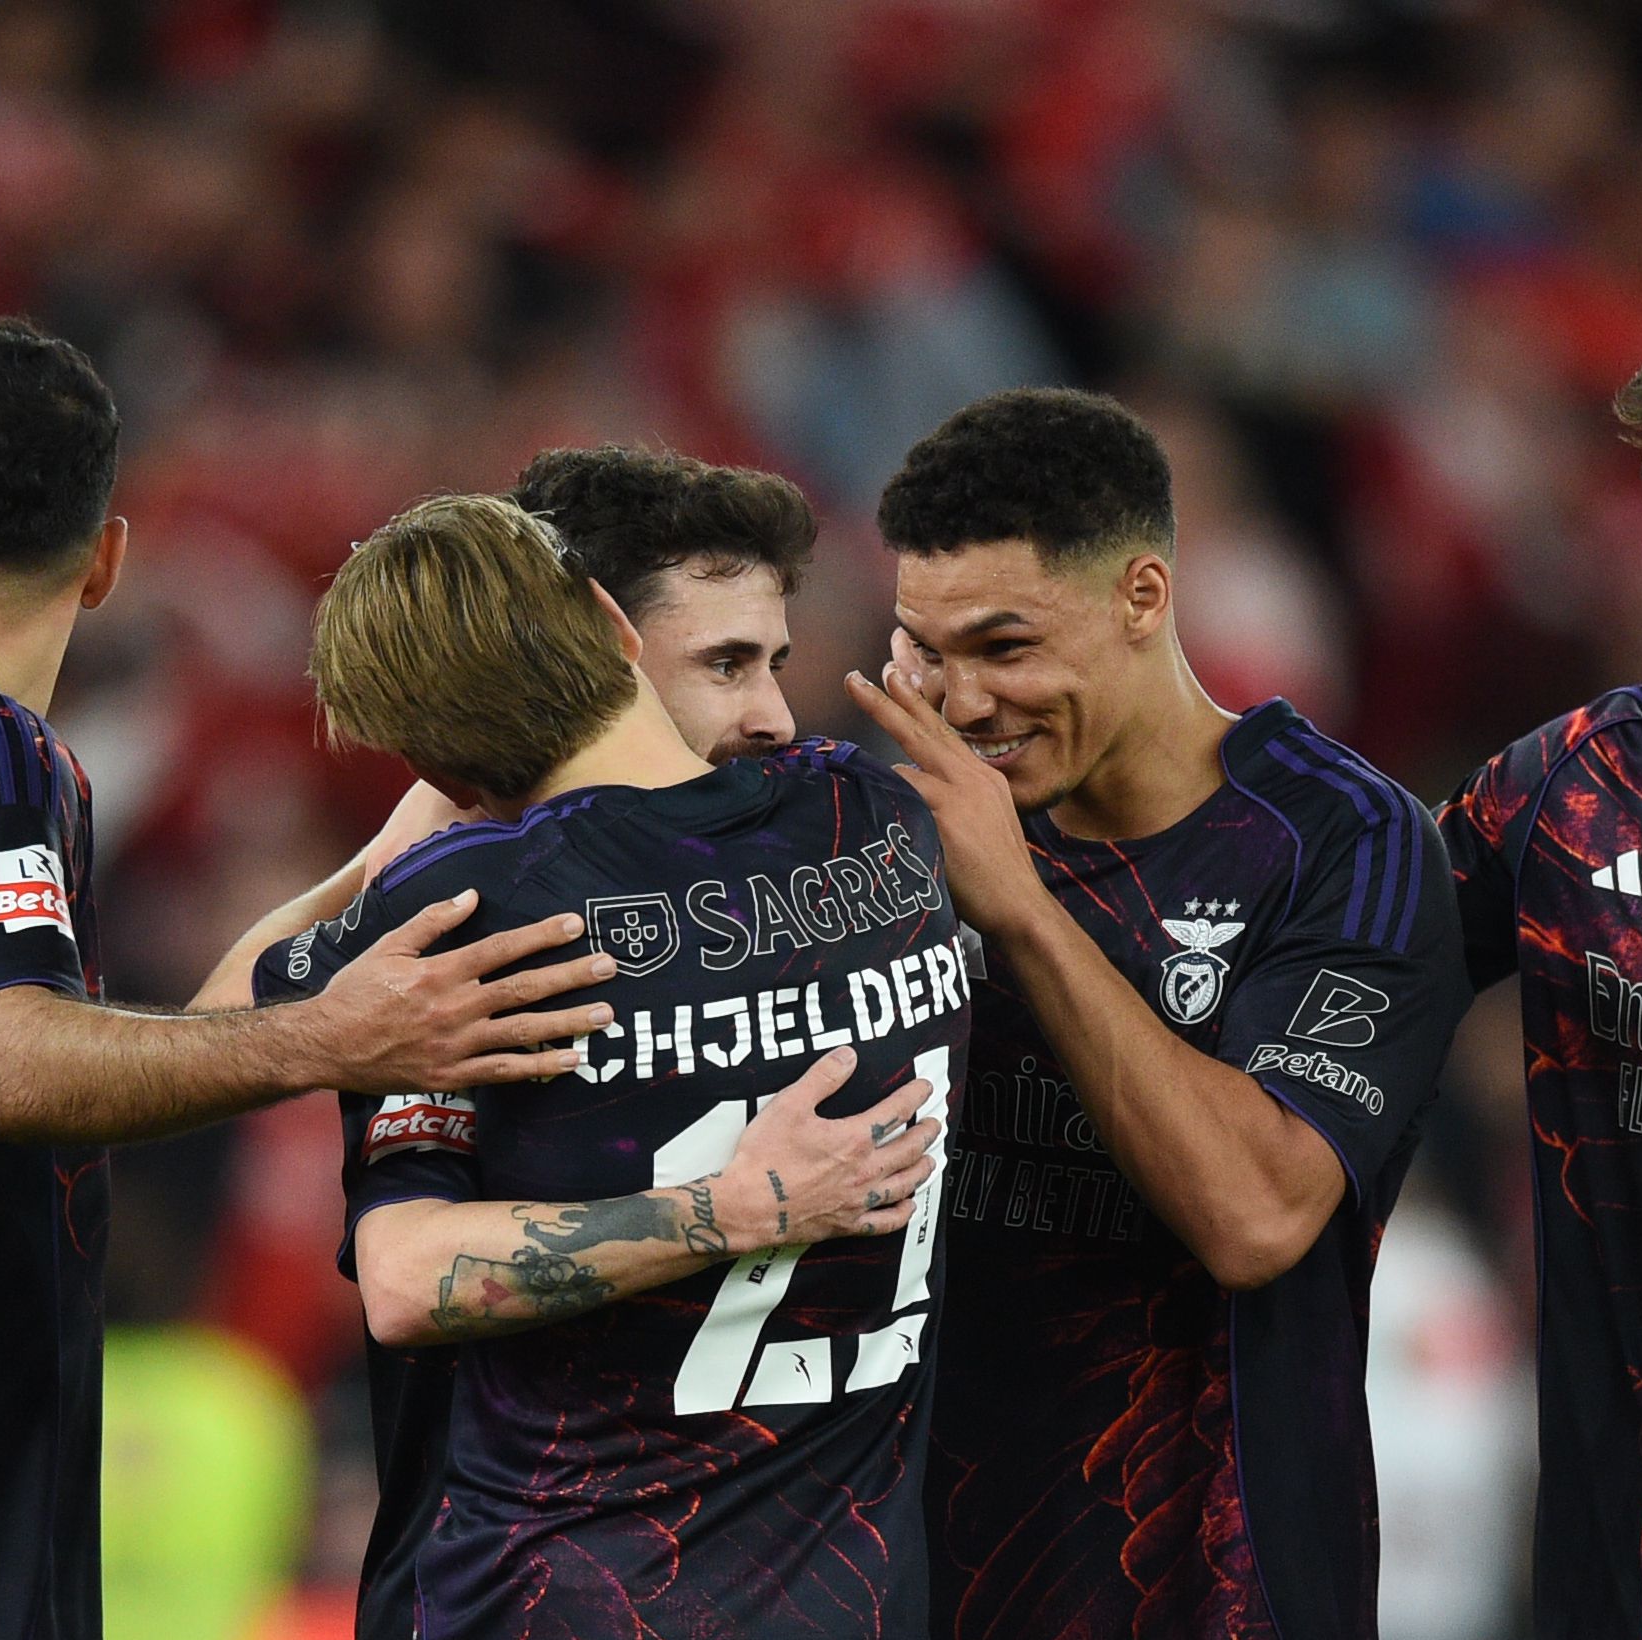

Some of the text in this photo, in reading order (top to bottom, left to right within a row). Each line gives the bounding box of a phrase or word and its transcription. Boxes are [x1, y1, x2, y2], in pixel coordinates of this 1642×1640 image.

[685, 823, 943, 971] SAGRES
[525, 935, 970, 1085] CHJELDER
[1245, 1043, 1385, 1117] Betano
[1004, 1159, 1148, 1243] BETTE
